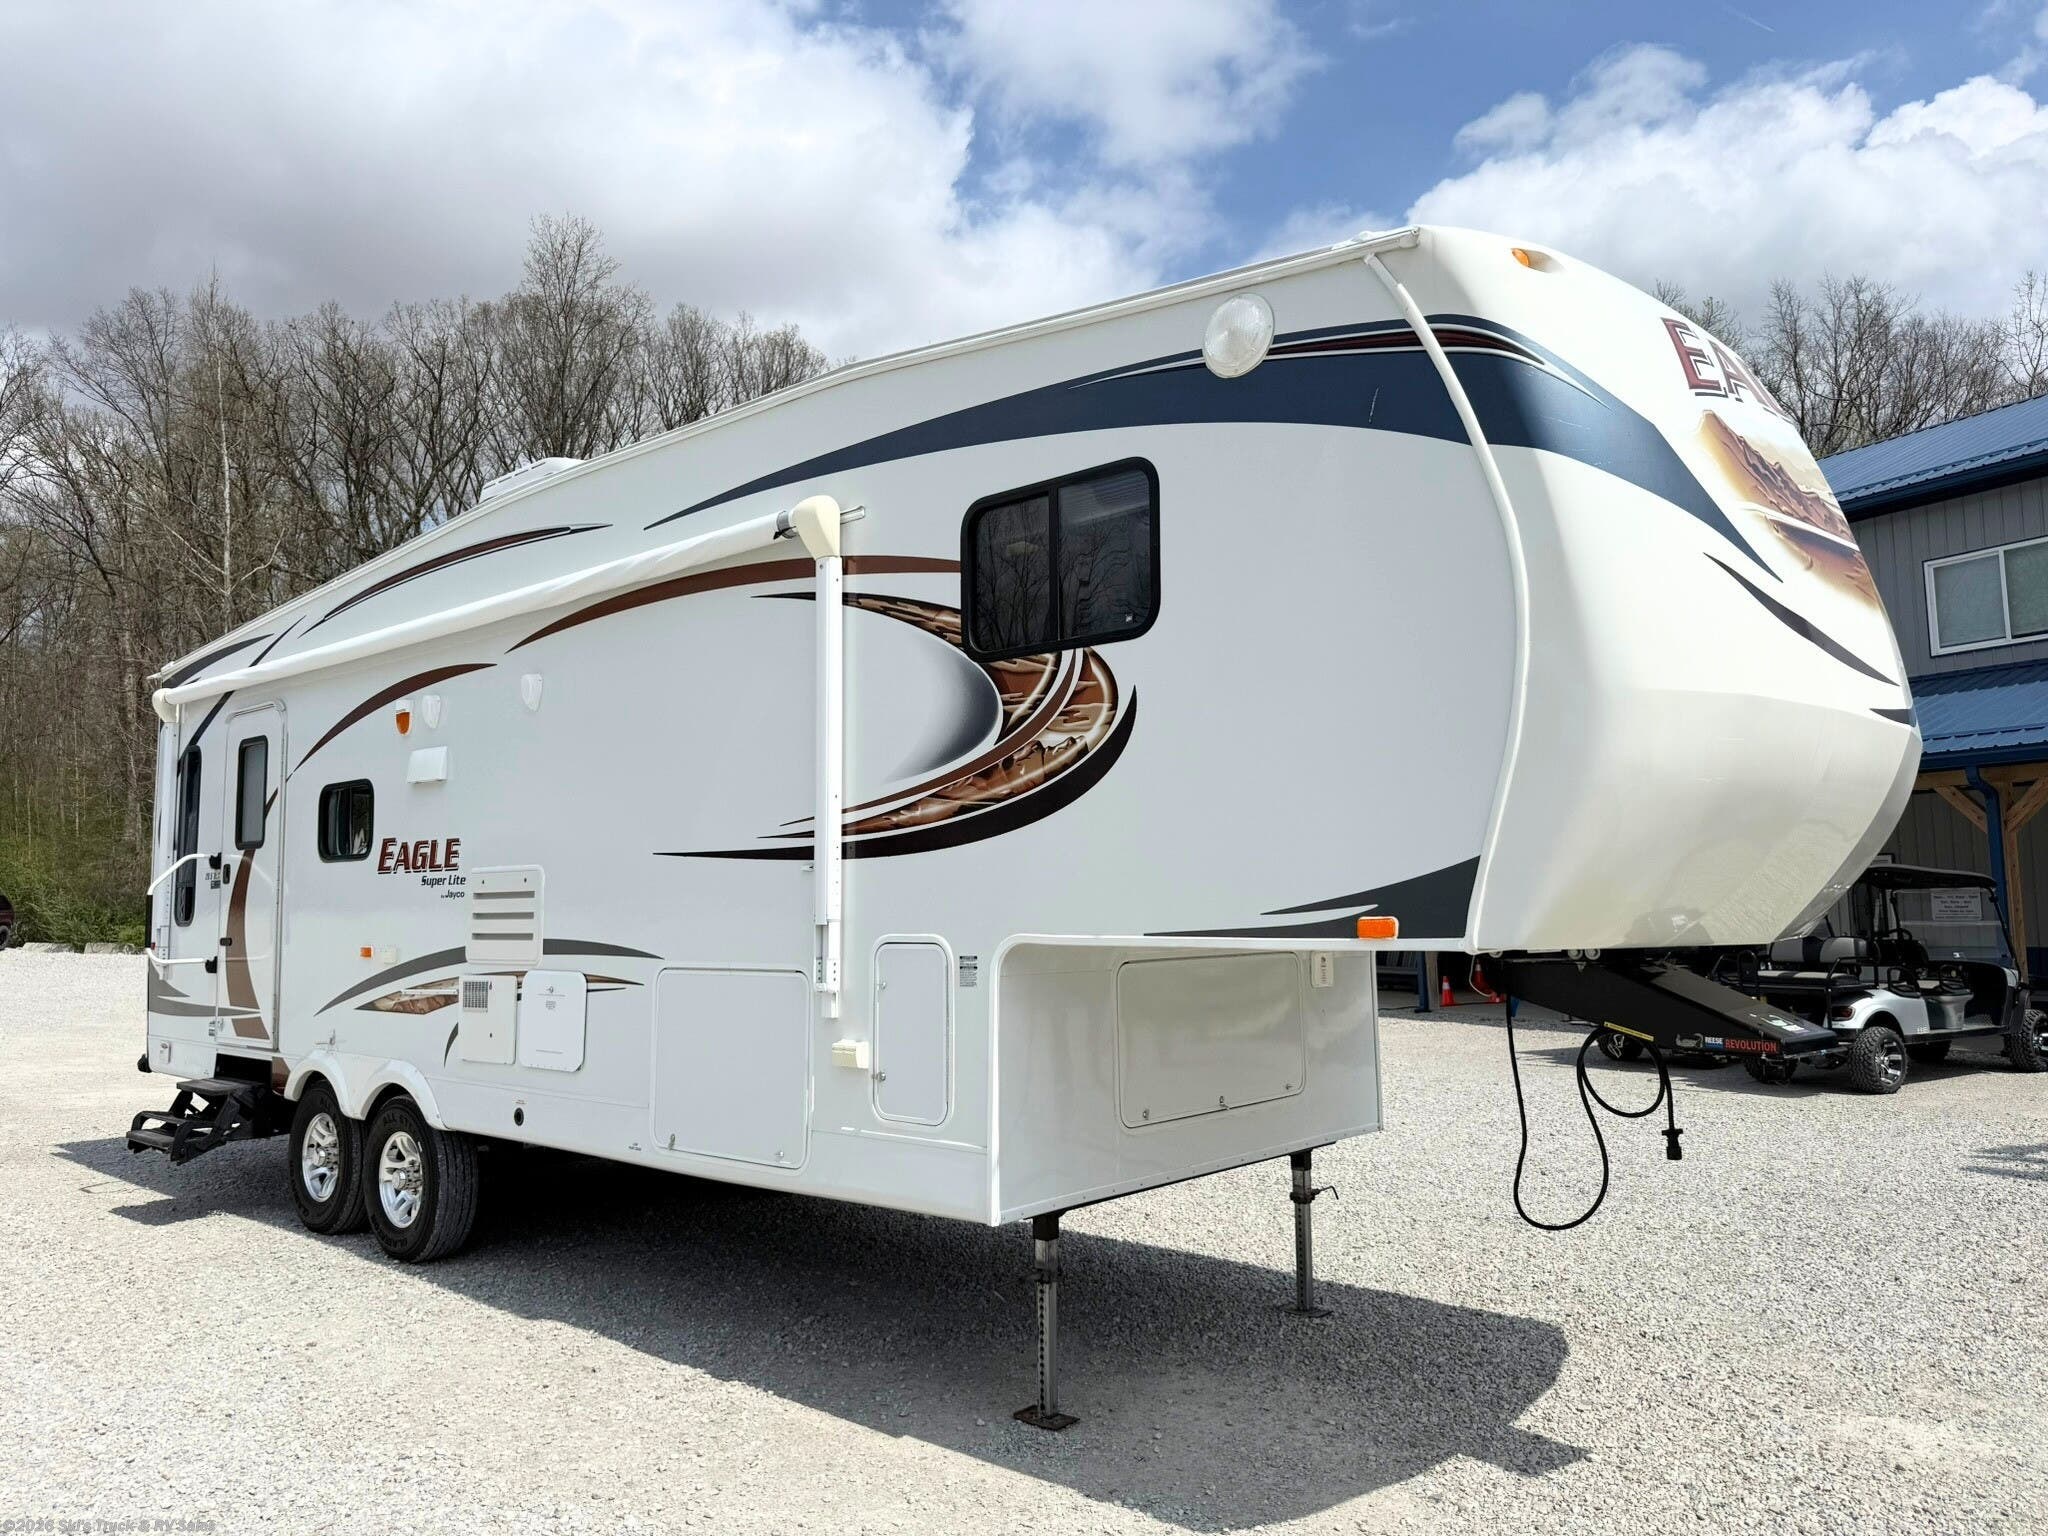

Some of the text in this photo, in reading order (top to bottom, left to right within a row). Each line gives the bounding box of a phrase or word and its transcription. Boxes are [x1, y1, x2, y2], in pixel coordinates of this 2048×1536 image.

[1661, 317, 1788, 422] EA
[377, 837, 461, 874] EAGLE
[420, 874, 467, 888] Super Lite
[445, 889, 465, 900] Jayco
[1704, 1036, 1777, 1052] REESE REVOLUTION
